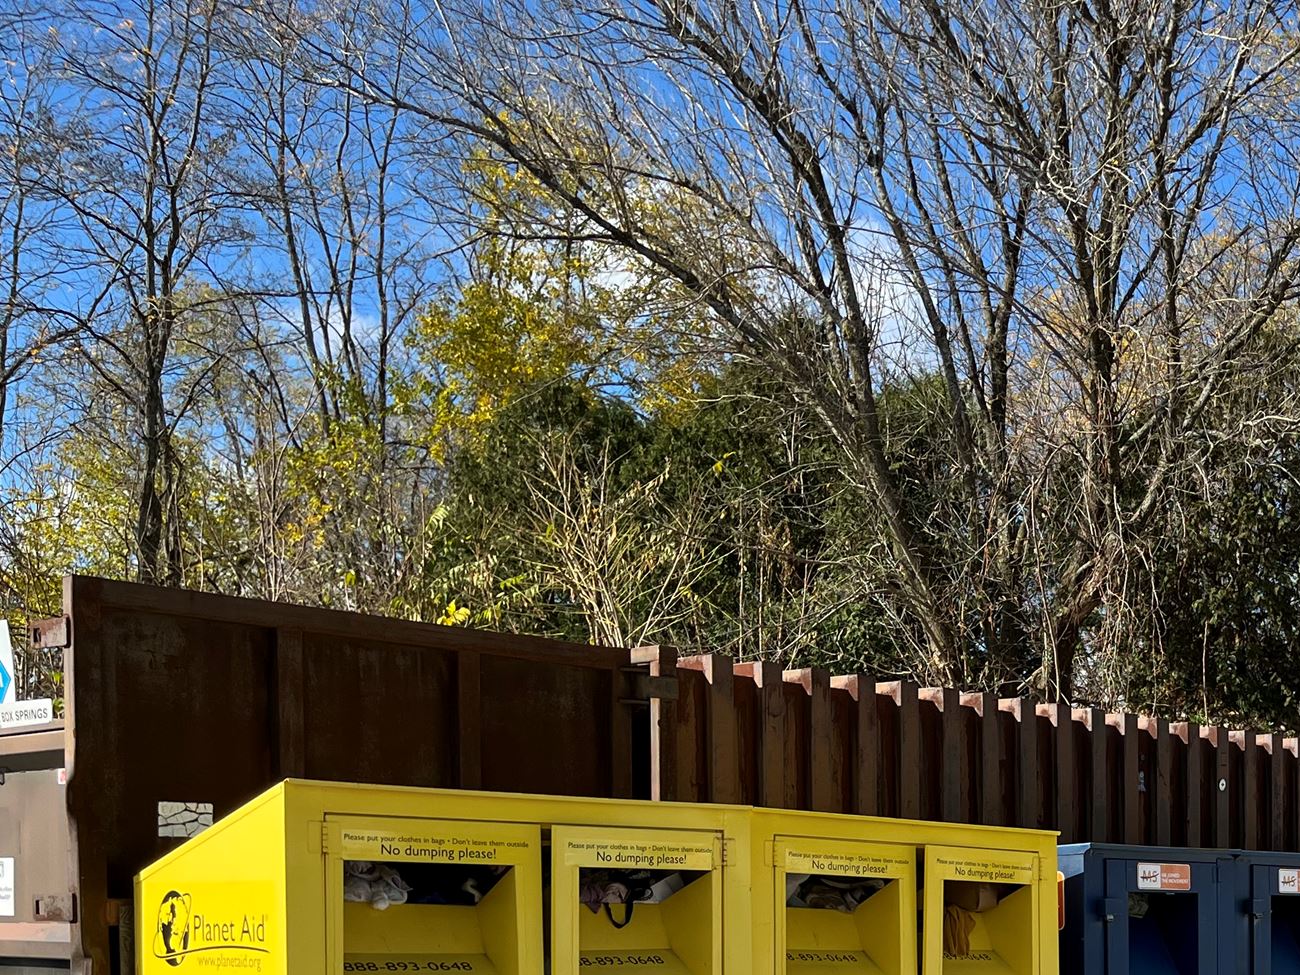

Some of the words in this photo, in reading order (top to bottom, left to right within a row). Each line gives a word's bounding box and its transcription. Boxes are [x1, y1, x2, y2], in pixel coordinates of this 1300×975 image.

[2, 710, 13, 722] BOX
[16, 708, 48, 721] SPRINGS
[431, 837, 445, 845] bags
[381, 845, 400, 855] No
[404, 845, 455, 860] dumping
[458, 849, 496, 860] please!
[597, 852, 611, 862] No
[615, 852, 654, 865] dumping
[657, 855, 686, 866] please!
[812, 860, 825, 869] No
[828, 861, 860, 874] dumping
[863, 864, 888, 874] please!
[955, 867, 965, 875] No
[967, 868, 993, 880] dumping
[995, 871, 1015, 880] please!
[193, 914, 234, 943] Planet
[241, 914, 265, 942] Aid
[198, 956, 261, 972] www.planetaid.org
[344, 962, 472, 971] 888-893-0648
